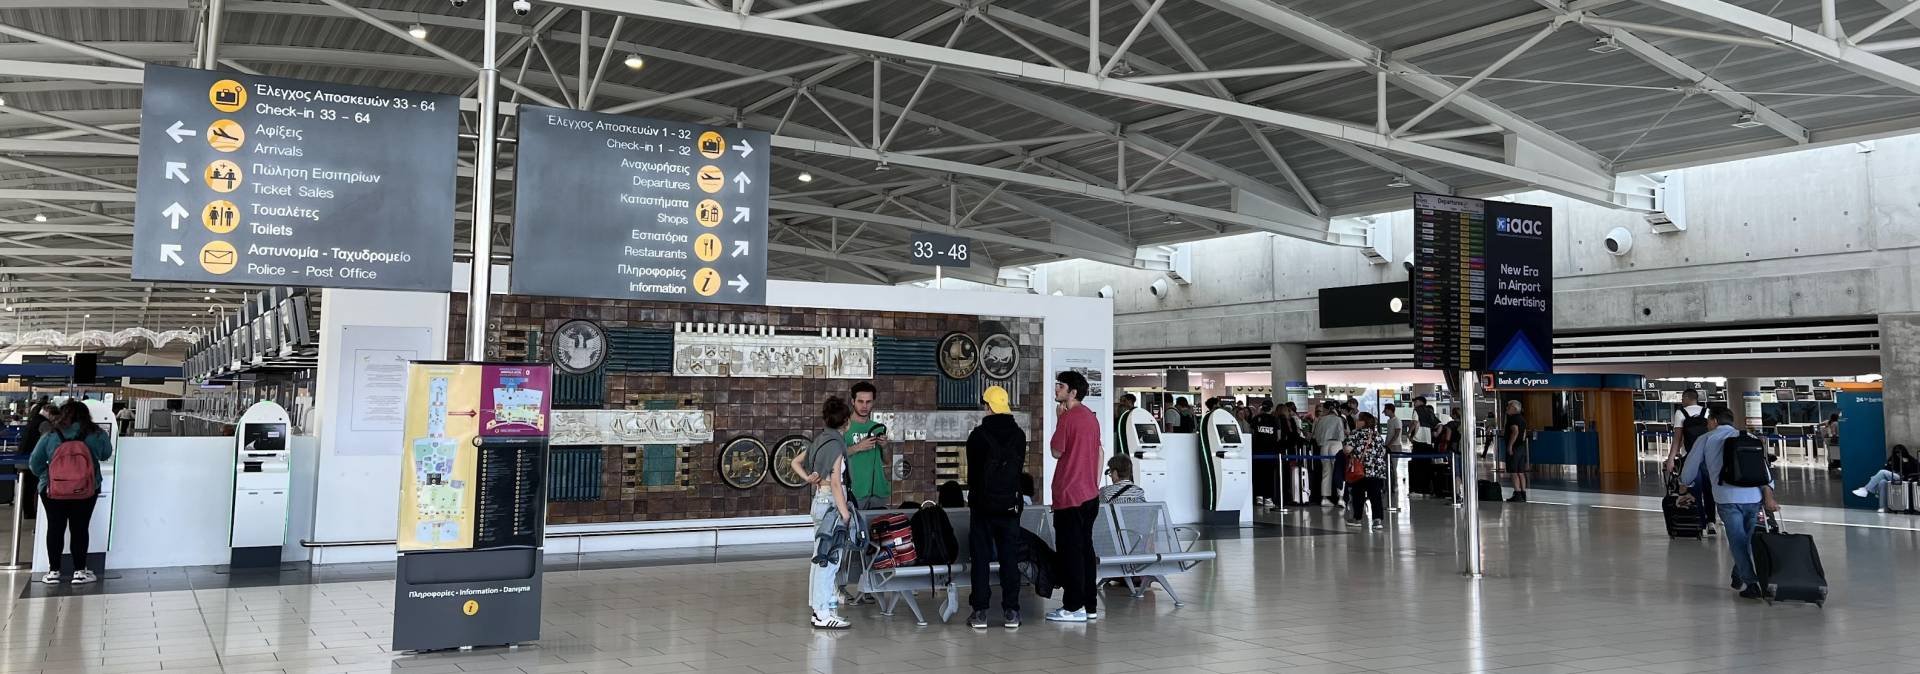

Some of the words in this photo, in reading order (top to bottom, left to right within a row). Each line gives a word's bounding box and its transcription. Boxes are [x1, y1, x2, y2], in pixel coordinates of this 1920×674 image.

[254, 83, 311, 102] Έλεγχος
[314, 90, 390, 108] Αποσκευών
[393, 98, 408, 110] 33
[420, 100, 435, 112] 64
[256, 103, 314, 119] Check-in
[320, 109, 336, 121] 33
[355, 112, 370, 124] 64
[255, 125, 303, 141] Αφίξεις
[596, 120, 659, 136] Αποσκευών
[662, 128, 667, 137] 1
[678, 130, 691, 139] 32
[255, 144, 303, 157] Arrivals
[607, 139, 653, 152] Check-in
[659, 144, 663, 153] 1
[679, 146, 691, 156] 32
[252, 163, 307, 181] Πώληση
[312, 167, 380, 185] Εισιτηρίων
[621, 158, 690, 176] Αναχωρήσεις
[633, 176, 690, 190] Departures
[253, 183, 291, 197] Ticket
[299, 186, 334, 199] Sales
[621, 193, 689, 208] Καταστήματα
[1438, 198, 1463, 206] Departures
[252, 203, 320, 221] Τουαλέτες
[658, 213, 688, 225] Shops
[250, 223, 293, 236] Toilets
[1507, 217, 1542, 235] iaac
[632, 230, 688, 244] Εστιατόρια
[248, 244, 318, 260] Αστυνομία
[331, 248, 410, 264] Ταχυδρομείο
[625, 247, 687, 260] Restaurants
[914, 241, 933, 258] 33
[948, 244, 967, 260] 48
[248, 263, 285, 276] Police
[306, 266, 333, 278] Post
[340, 267, 376, 279] Office
[618, 265, 686, 279] Πληροφορίες
[1501, 264, 1521, 275] New
[1523, 265, 1539, 276] Era
[630, 282, 686, 294] Information
[1498, 278, 1506, 290] in
[1508, 280, 1541, 293] Airport
[1494, 294, 1545, 311] Advertising
[1522, 378, 1549, 386] Cyprus
[409, 590, 455, 598] Πληροφορίες
[460, 588, 498, 596] Information
